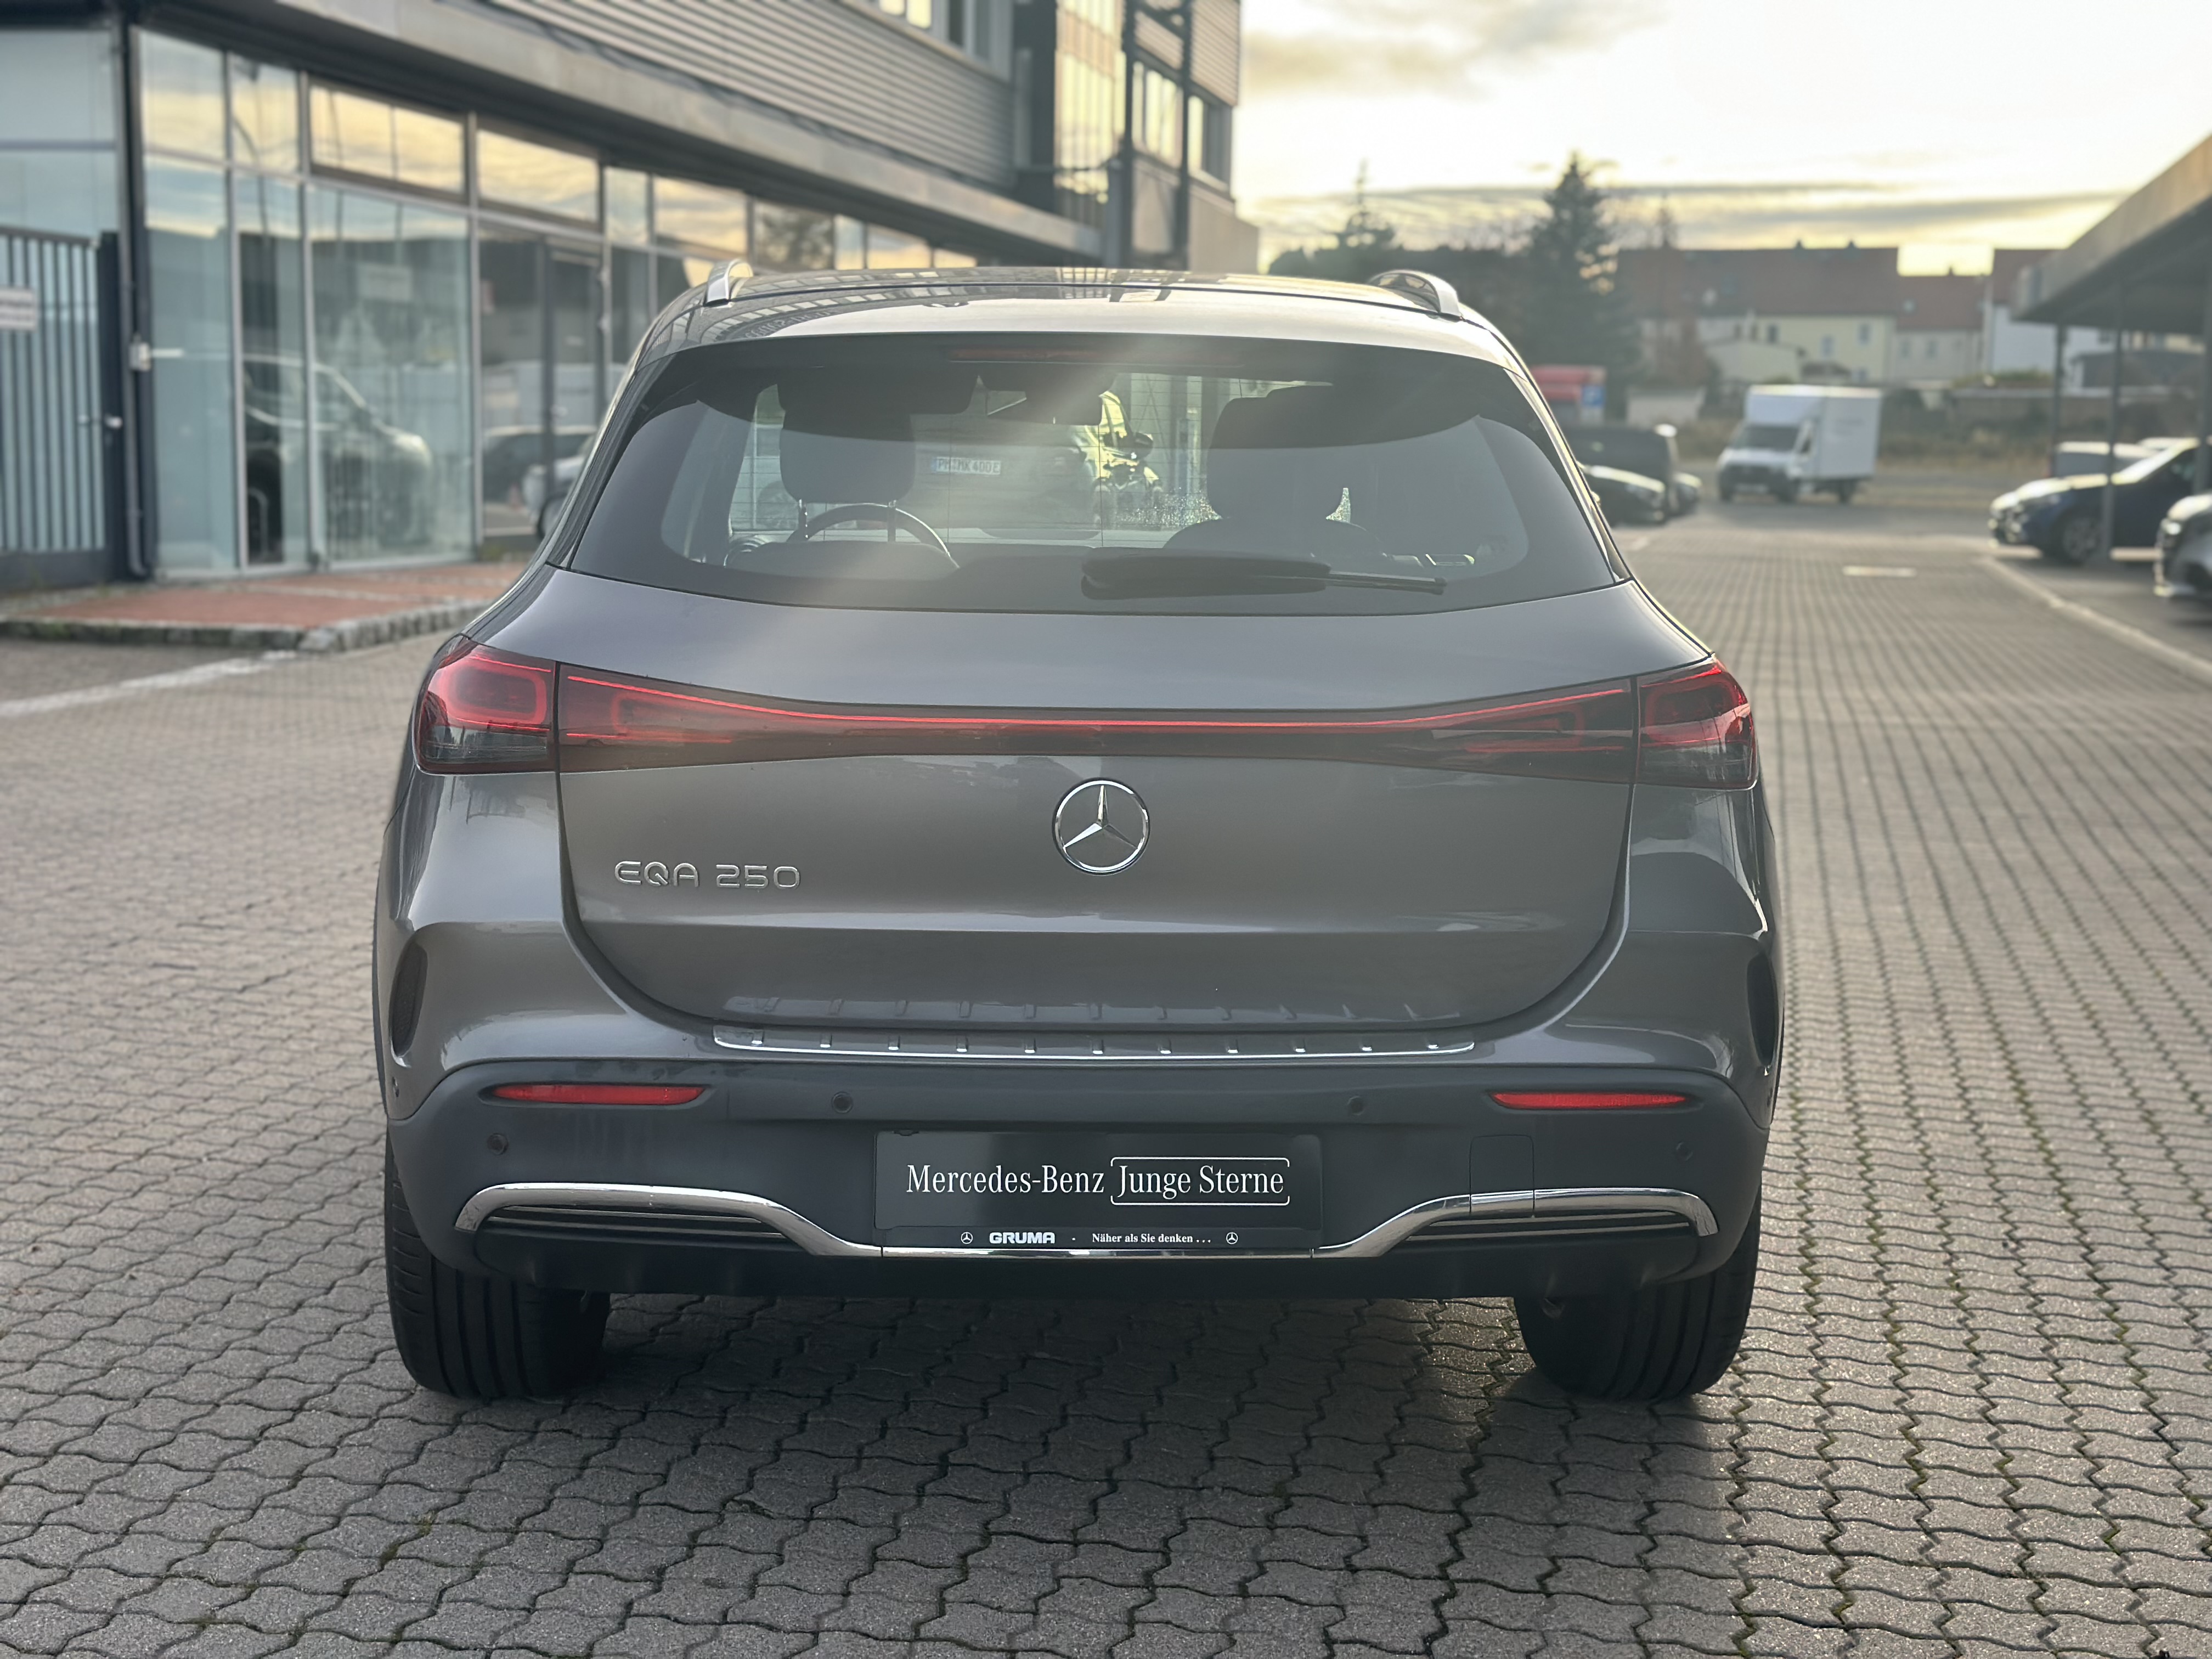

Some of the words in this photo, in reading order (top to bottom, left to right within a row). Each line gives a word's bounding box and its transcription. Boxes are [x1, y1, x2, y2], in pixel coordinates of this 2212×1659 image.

[614, 860, 699, 887] EQA
[716, 864, 800, 889] 250
[906, 1164, 1105, 1194] Mercedes-Benz
[1117, 1165, 1192, 1200] Junge
[1199, 1164, 1284, 1194] Sterne
[989, 1232, 1056, 1244] GRUMA
[1092, 1232, 1122, 1243] Näher
[1124, 1233, 1138, 1243] als
[1141, 1233, 1155, 1243] Sie
